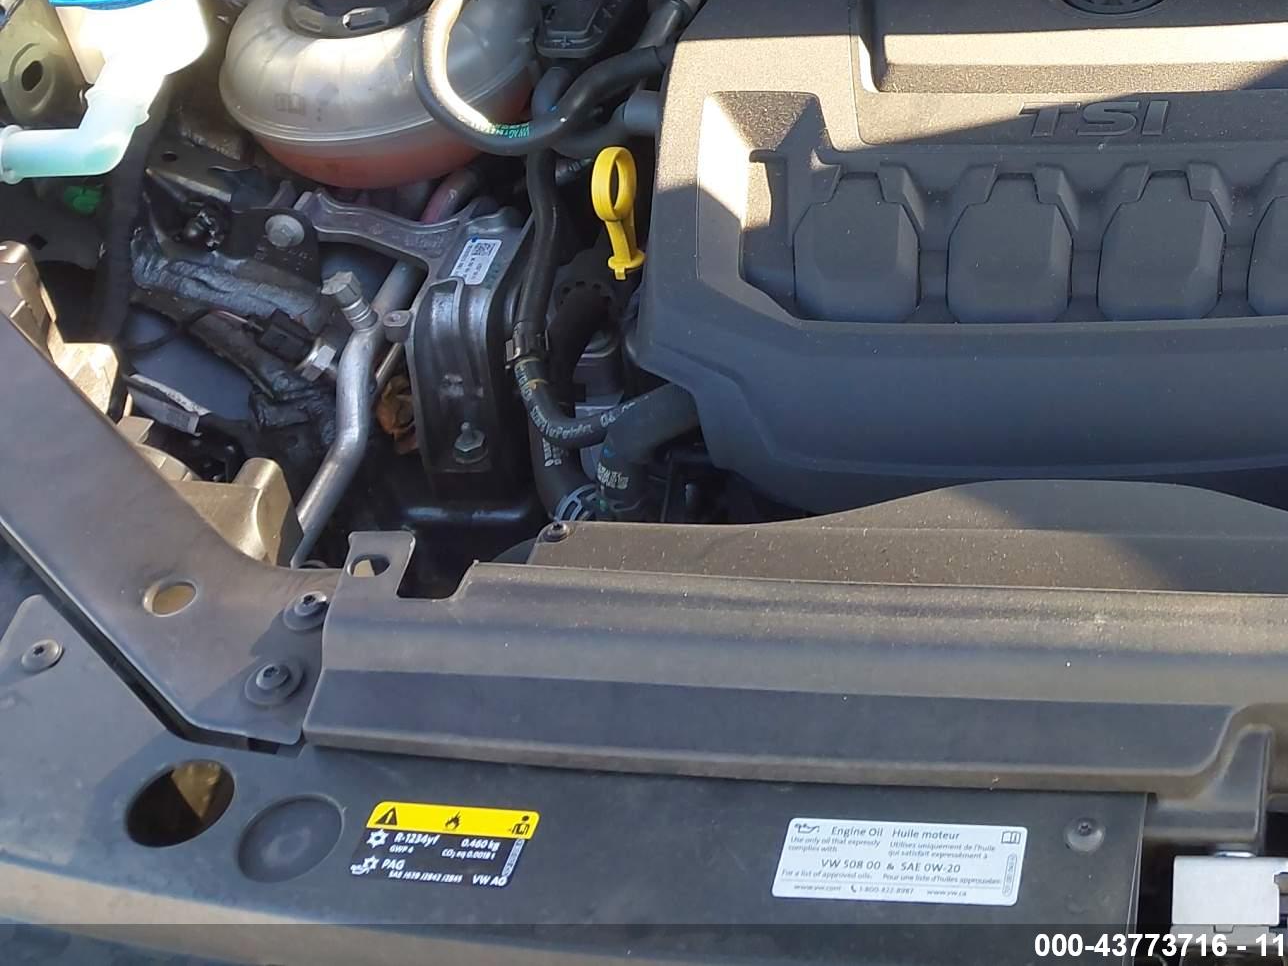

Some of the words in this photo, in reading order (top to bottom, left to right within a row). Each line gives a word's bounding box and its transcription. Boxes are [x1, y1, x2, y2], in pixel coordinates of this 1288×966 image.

[1018, 100, 1169, 136] TSI
[831, 826, 867, 838] Engine
[868, 827, 884, 837] Oil
[892, 829, 918, 839] Huile
[922, 830, 961, 840] moteur
[393, 832, 440, 847] R-1234yf
[461, 838, 487, 849] 0.460
[488, 841, 500, 852] kg
[805, 837, 820, 845] only
[847, 839, 881, 847] expressly
[389, 845, 408, 853] GWP
[964, 843, 972, 851] de
[381, 859, 405, 870] PAG
[821, 859, 841, 868] VW
[843, 860, 863, 869] 508
[866, 861, 881, 870] 00
[886, 863, 895, 871] &
[900, 862, 921, 872] SAE
[472, 874, 490, 885] VW
[782, 869, 794, 877] For
[800, 870, 812, 878] list
[813, 870, 821, 878] of
[822, 871, 857, 880] approved
[882, 873, 899, 881] Pour
[915, 874, 930, 882] liste
